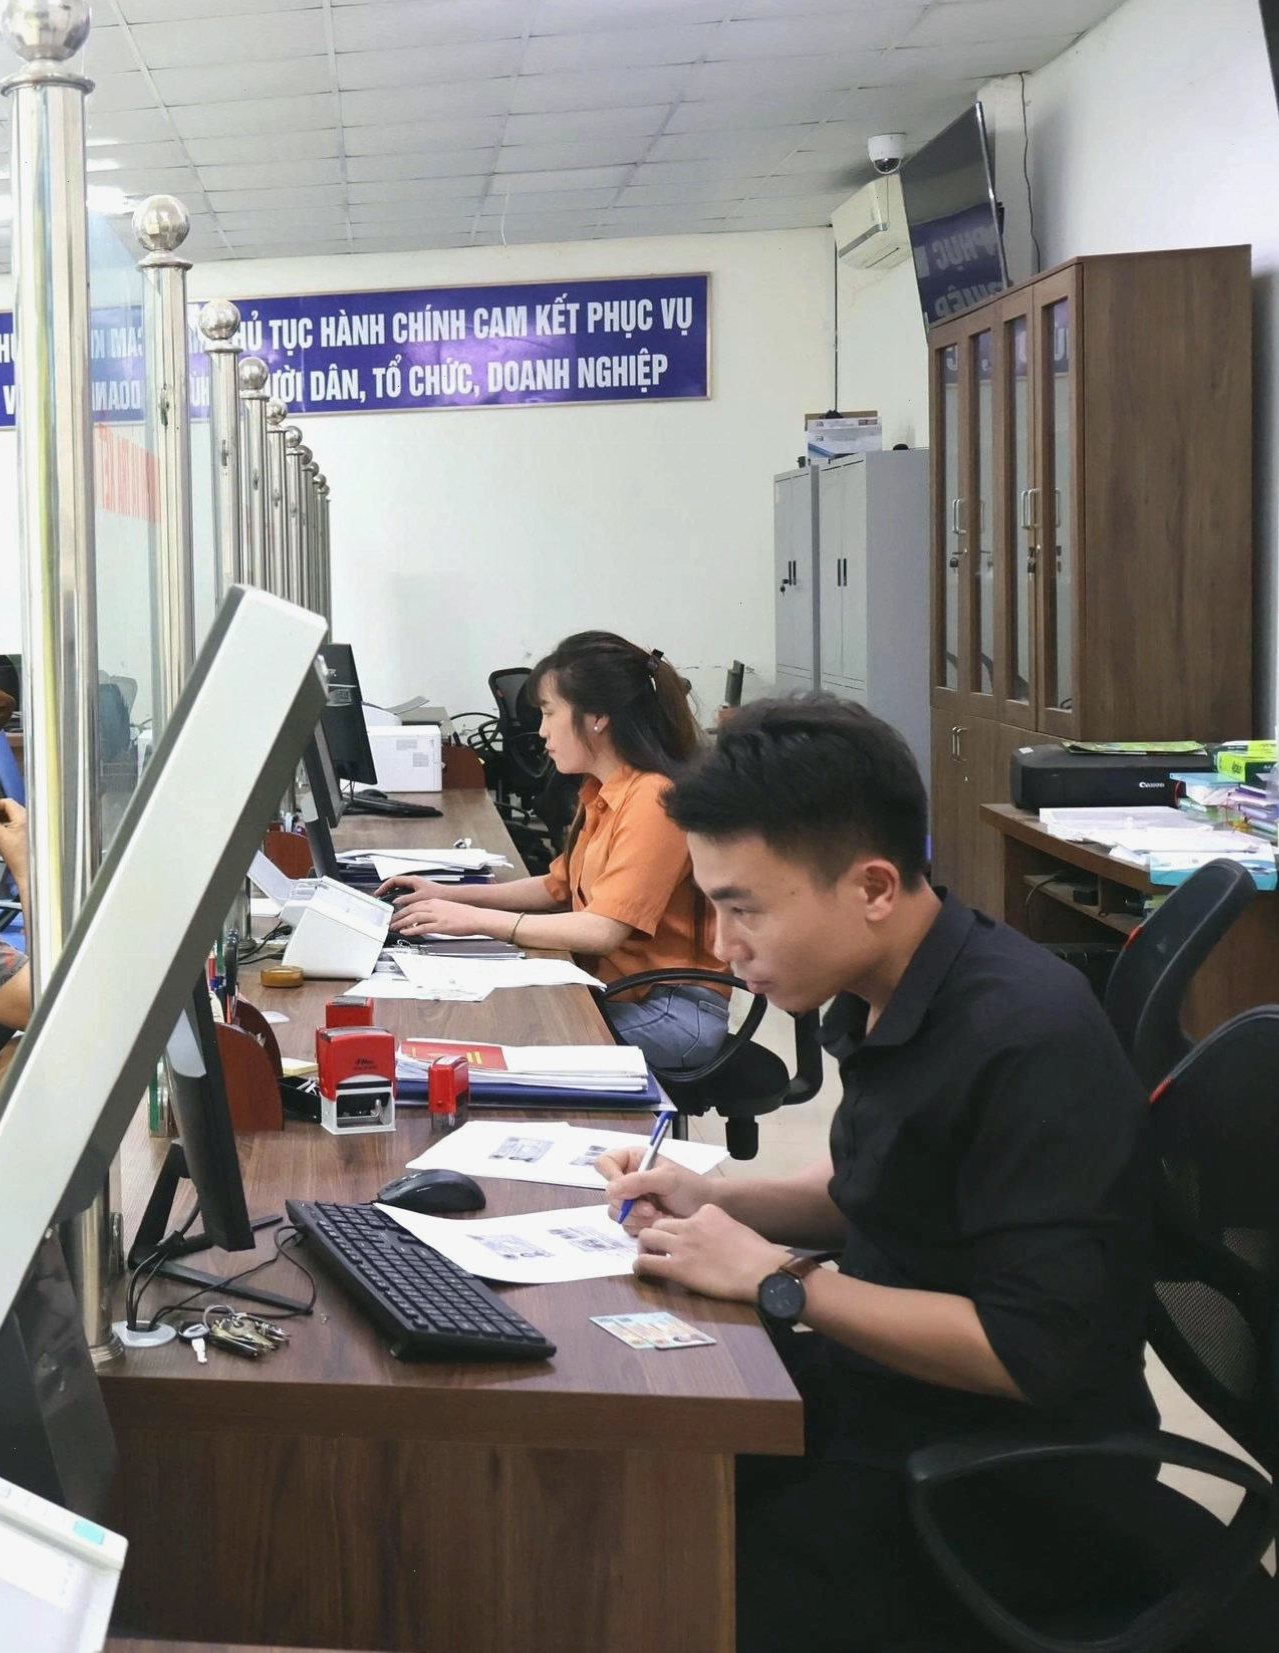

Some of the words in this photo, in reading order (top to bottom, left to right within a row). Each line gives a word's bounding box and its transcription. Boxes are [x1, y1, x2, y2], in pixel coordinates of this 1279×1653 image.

[231, 310, 263, 351] HỦ
[269, 317, 314, 356] TỤC
[320, 309, 385, 348] HÀNH
[392, 304, 466, 344] CHÍNH
[474, 305, 528, 340] CAM
[536, 293, 581, 336] KẾT
[587, 298, 653, 339] PHỤC
[661, 297, 693, 336] VỤ
[268, 365, 302, 403] ƯỜI
[310, 363, 367, 404] DÂN,
[372, 354, 402, 398] TỔ
[408, 357, 480, 399] CHỨC,
[487, 358, 570, 393] DOANH
[578, 347, 668, 393] NGHIỆP
[1138, 781, 1165, 789] Canon
